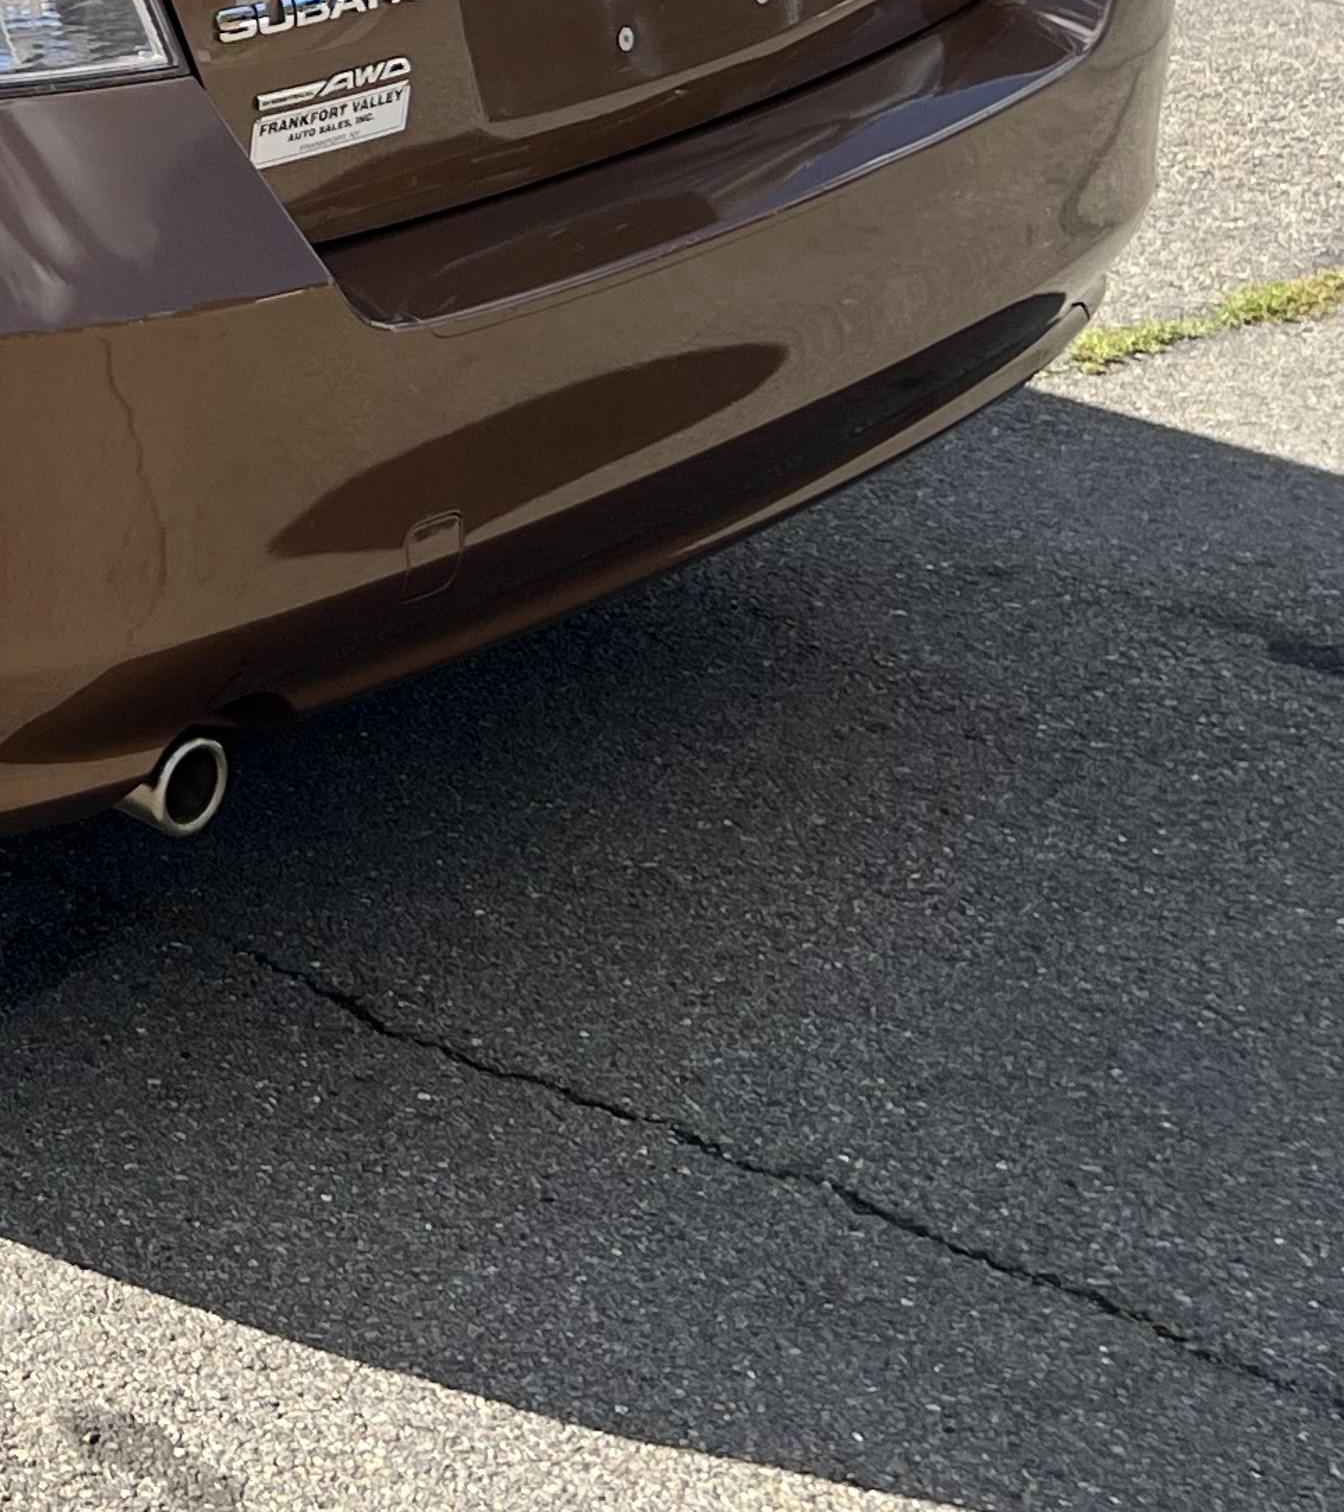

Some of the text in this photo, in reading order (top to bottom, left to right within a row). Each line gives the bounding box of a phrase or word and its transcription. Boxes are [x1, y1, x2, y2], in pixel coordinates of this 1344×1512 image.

[319, 58, 411, 96] AWD
[259, 88, 403, 137] FRANKFORT VALLEY
[288, 127, 316, 143] AUTO
